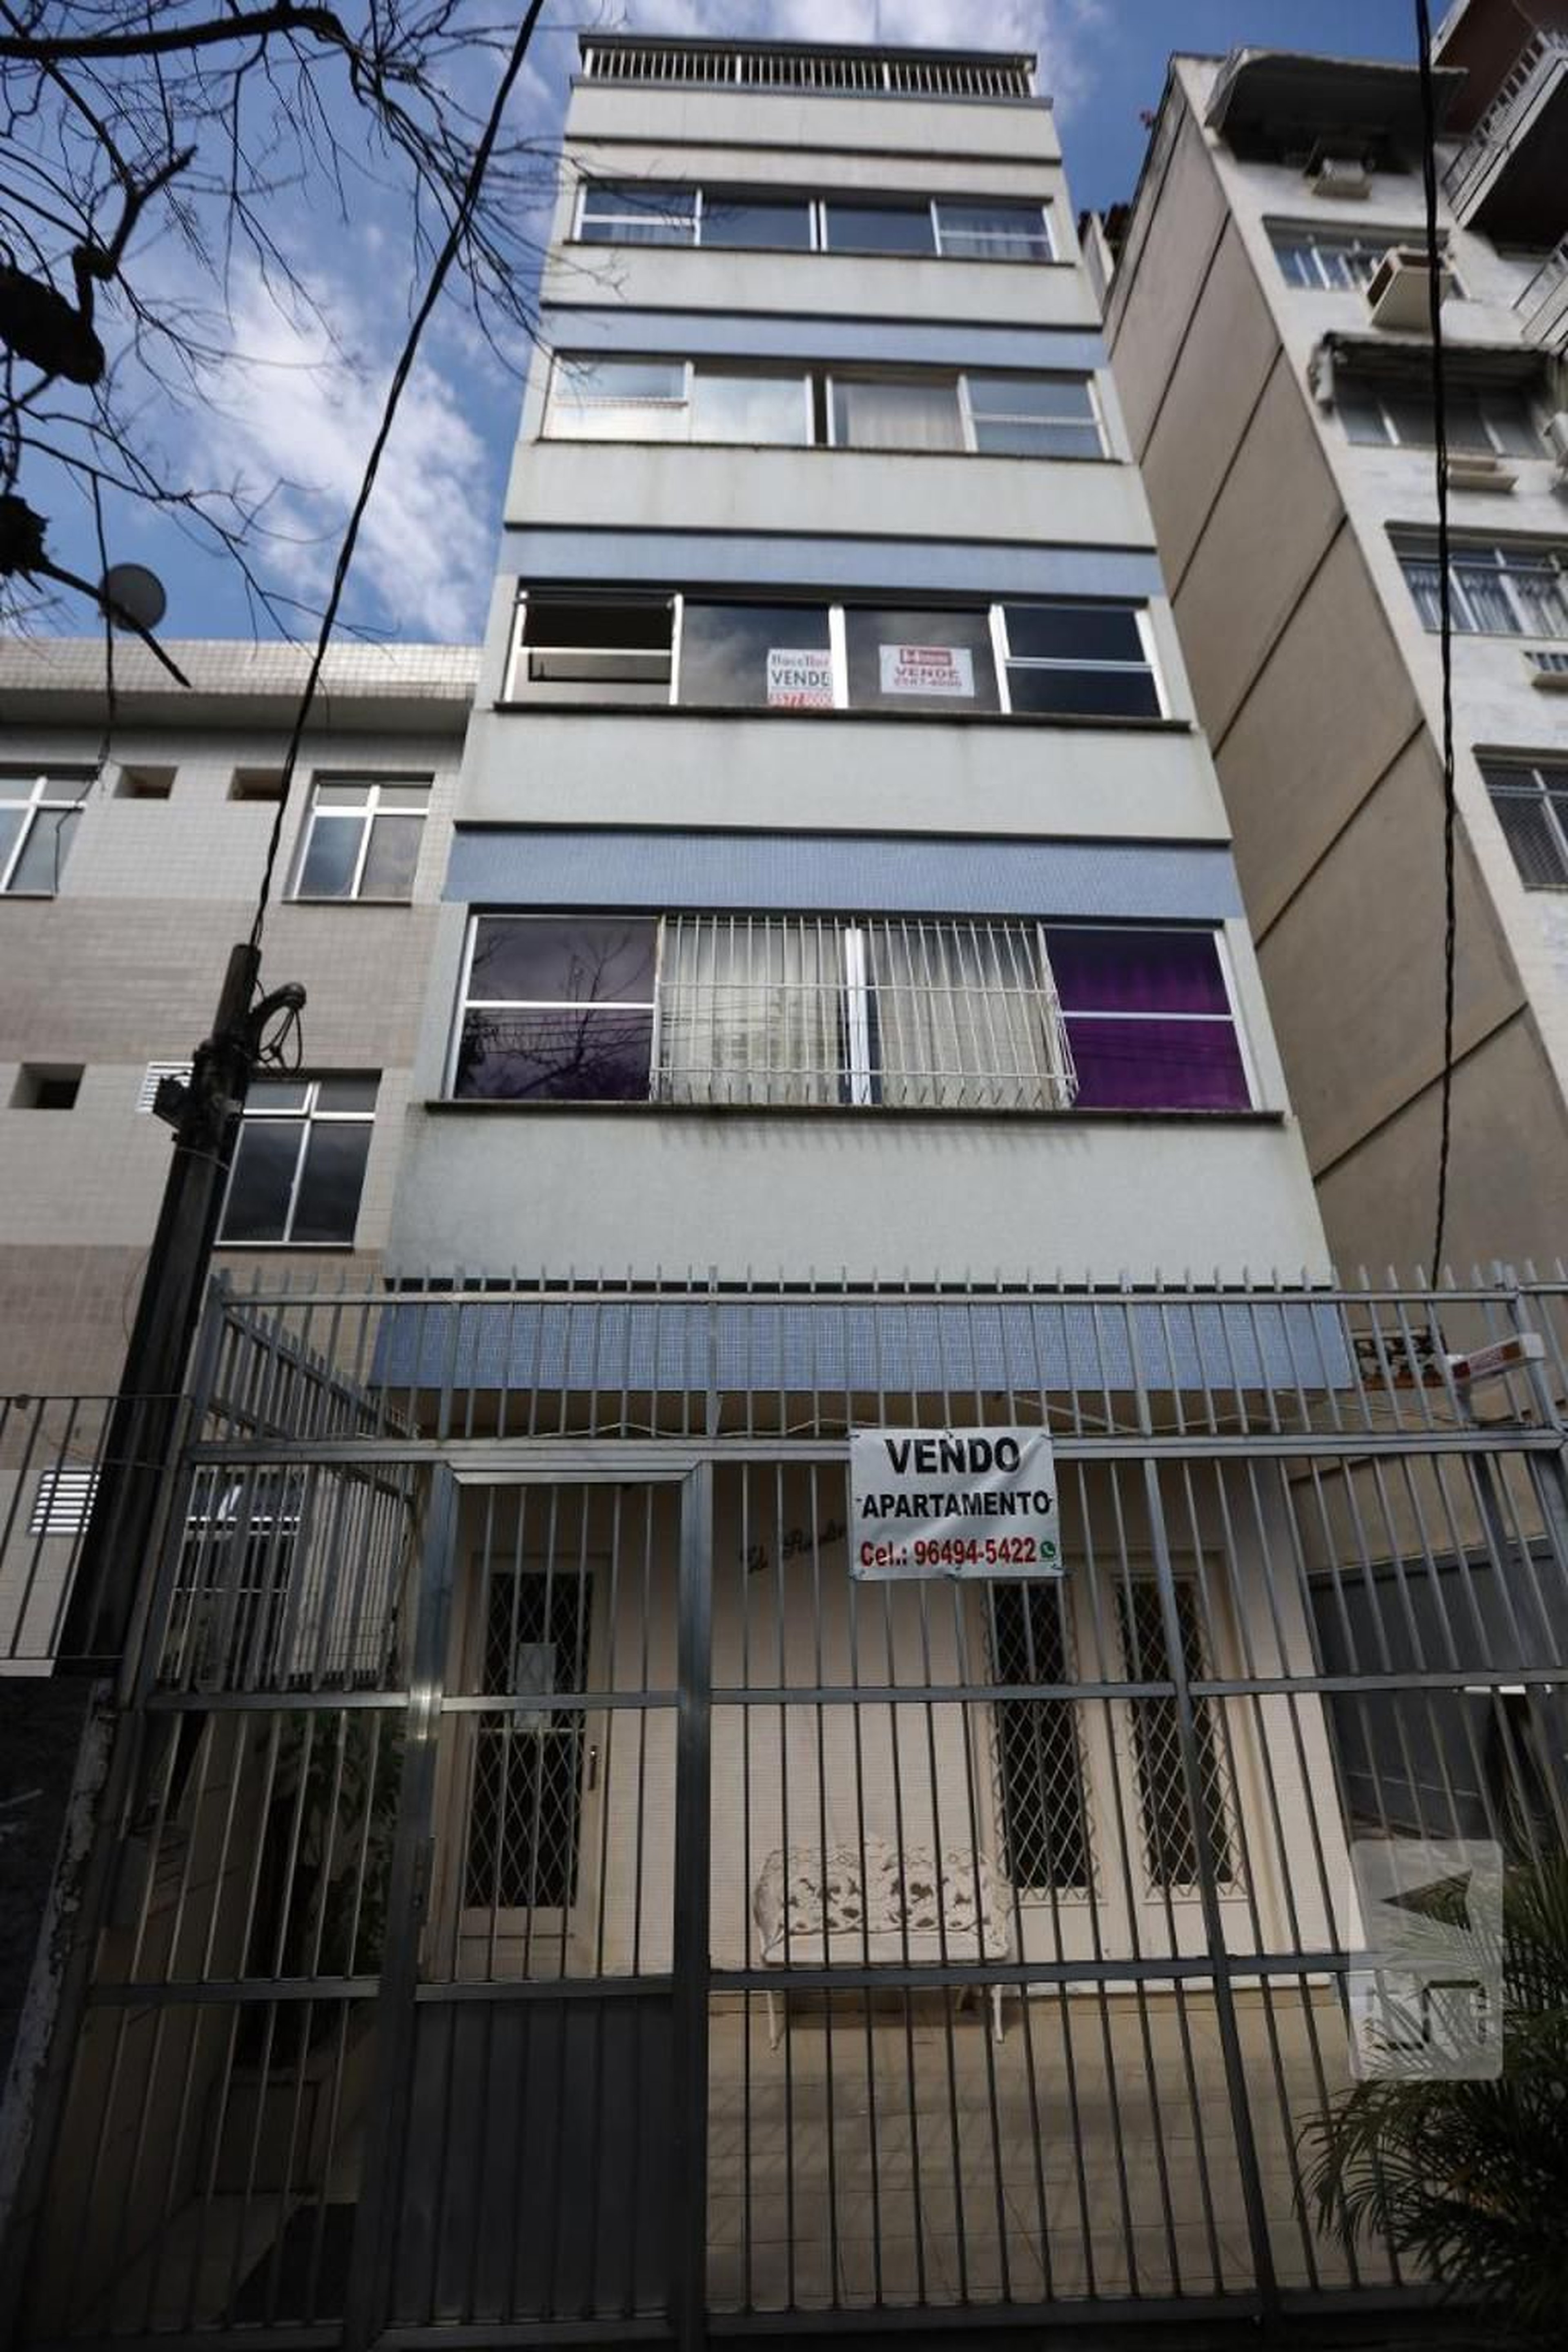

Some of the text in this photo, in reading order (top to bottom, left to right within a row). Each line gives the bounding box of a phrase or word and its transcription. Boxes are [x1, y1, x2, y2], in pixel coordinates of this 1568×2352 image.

[884, 1437, 1020, 1474] VENDO
[862, 1490, 1051, 1519] APARTAMENTO
[913, 1537, 1037, 1565] 96494-5422
